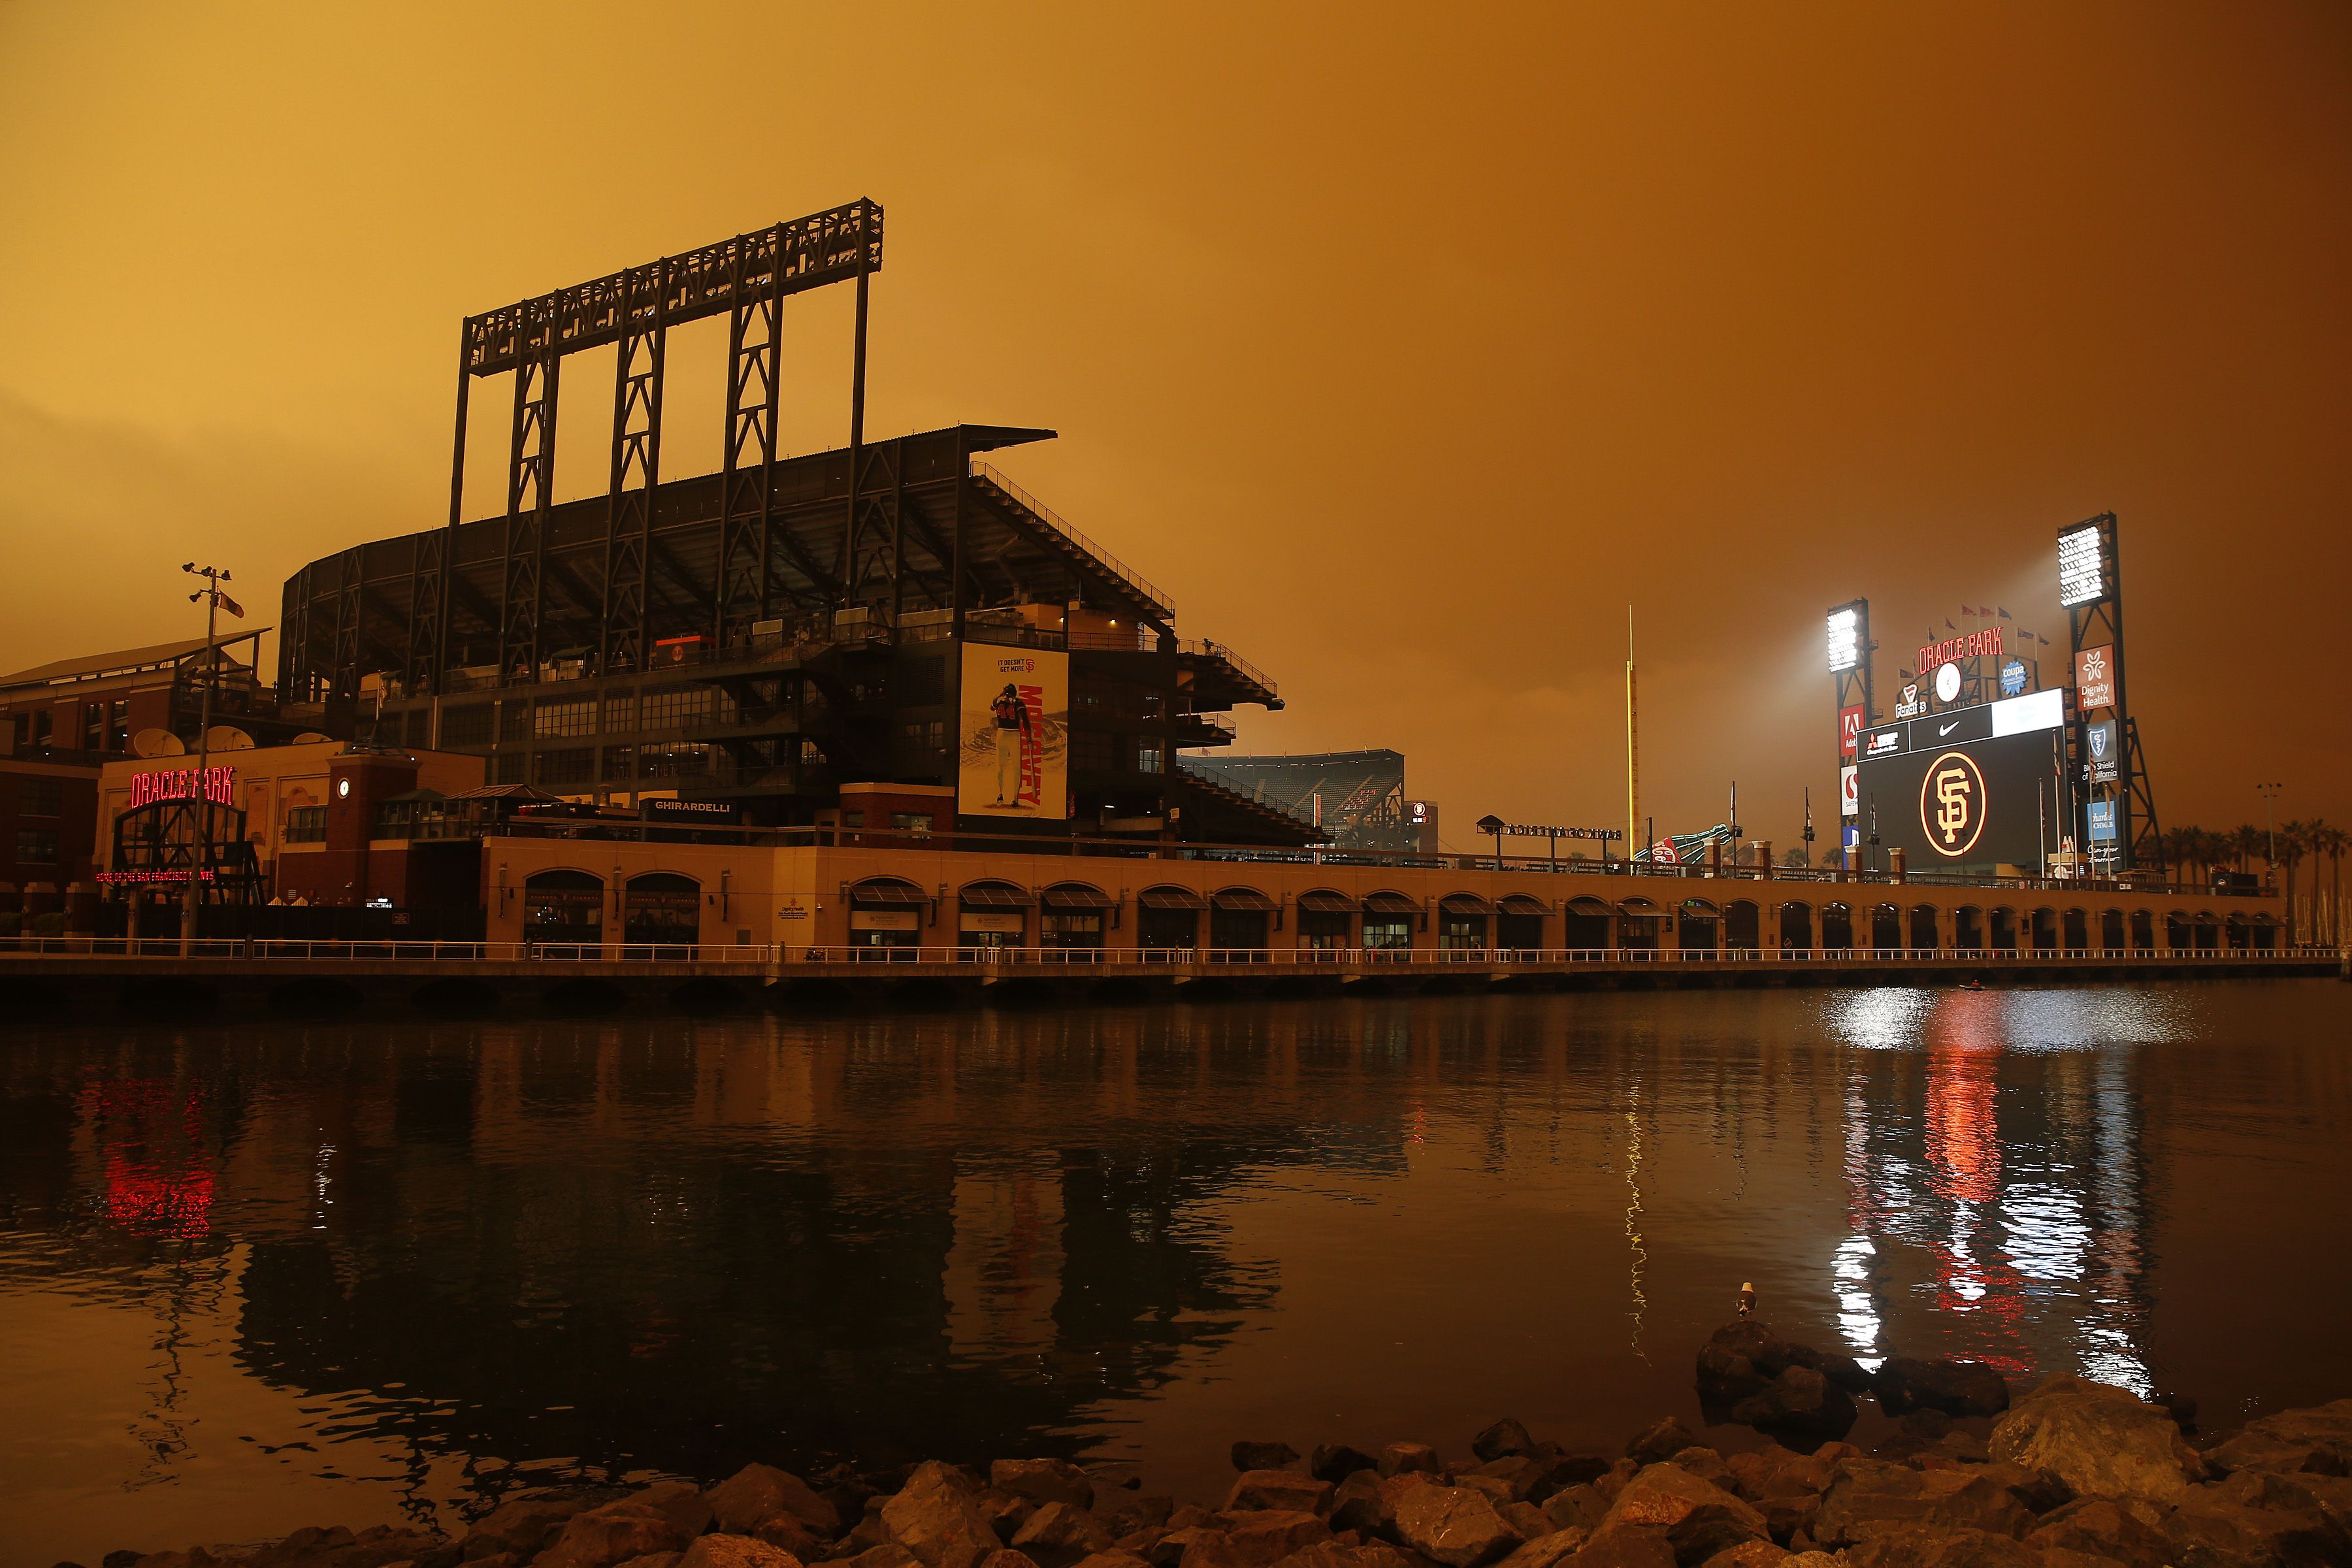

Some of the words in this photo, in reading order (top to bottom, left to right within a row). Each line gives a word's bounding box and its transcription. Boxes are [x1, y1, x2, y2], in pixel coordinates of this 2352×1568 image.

[1919, 638, 1964, 675] ORACLE
[1968, 626, 2003, 656] PARK
[2003, 665, 2024, 678] coupa
[2081, 683, 2109, 696] Dignity
[2083, 694, 2108, 708] Health
[996, 704, 1016, 720] 44
[1897, 703, 1925, 717] Fanats
[1845, 738, 1857, 748] Adob
[2097, 760, 2114, 770] Shield
[2094, 769, 2117, 779] alifornia
[131, 770, 188, 809] ORACLE
[191, 766, 235, 806] PARK
[655, 801, 730, 812] GHIRARDELLI
[2092, 811, 2112, 822] harls
[96, 872, 113, 882] HOME
[114, 872, 122, 882] OF
[123, 872, 135, 882] THE
[136, 872, 150, 881] SAN
[151, 872, 188, 881] FRANCISCO
[188, 871, 215, 881] GNTS
